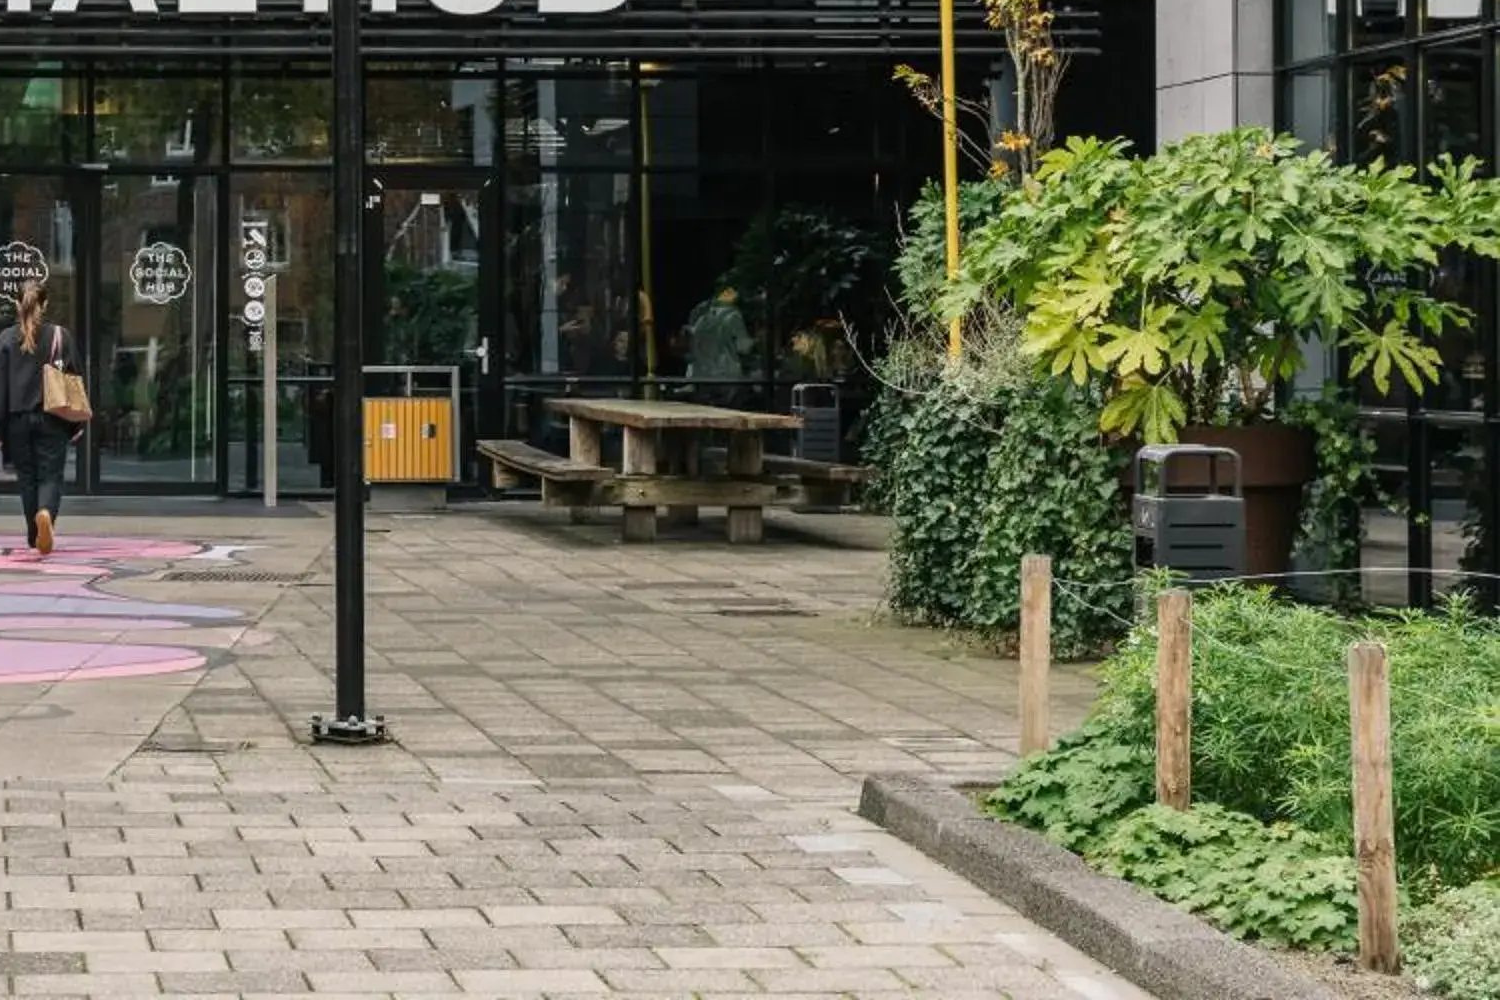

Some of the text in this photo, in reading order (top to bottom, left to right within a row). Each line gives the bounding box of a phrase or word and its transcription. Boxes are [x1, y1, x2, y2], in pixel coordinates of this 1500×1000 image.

[3, 253, 32, 263] THE
[148, 252, 175, 263] THE
[135, 267, 187, 279] SOCIAL
[145, 282, 176, 293] HUB
